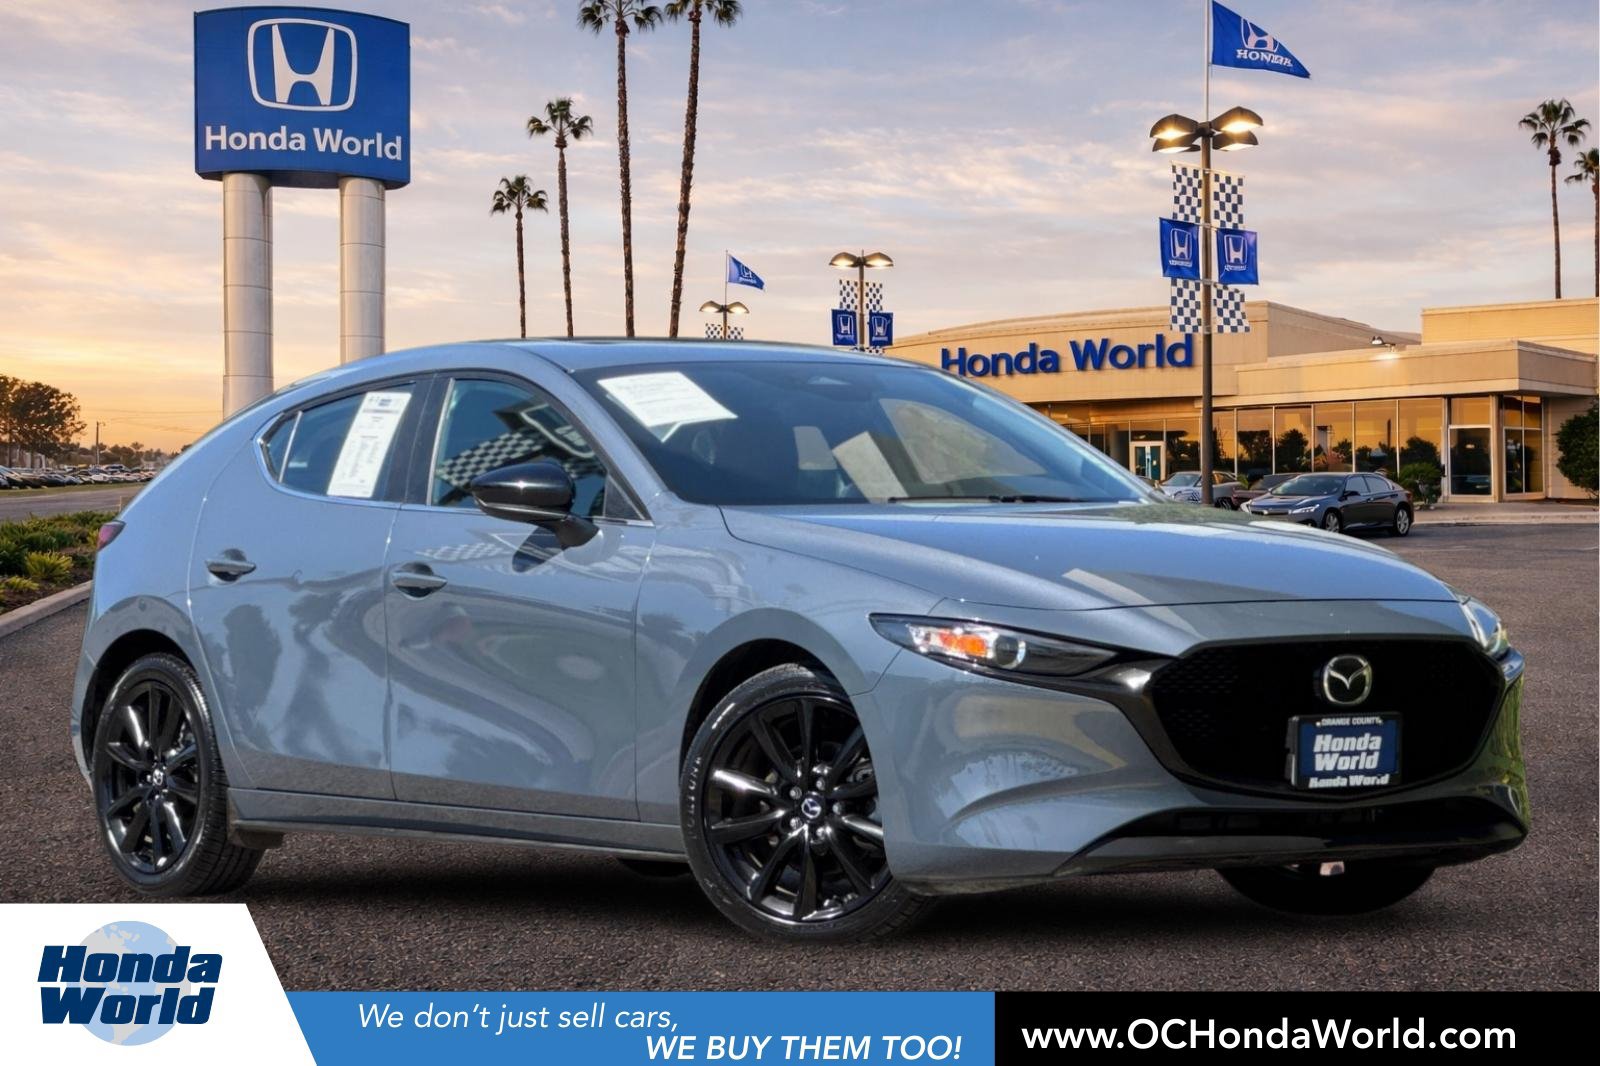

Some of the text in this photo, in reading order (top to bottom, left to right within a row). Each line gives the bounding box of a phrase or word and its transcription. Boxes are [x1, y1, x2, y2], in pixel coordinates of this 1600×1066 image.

[205, 125, 402, 161] Honda World
[941, 333, 1194, 377] Honda World
[1321, 717, 1350, 726] ORANGE
[1313, 732, 1383, 753] Honda
[1314, 751, 1380, 772] World
[1308, 775, 1348, 789] Honda
